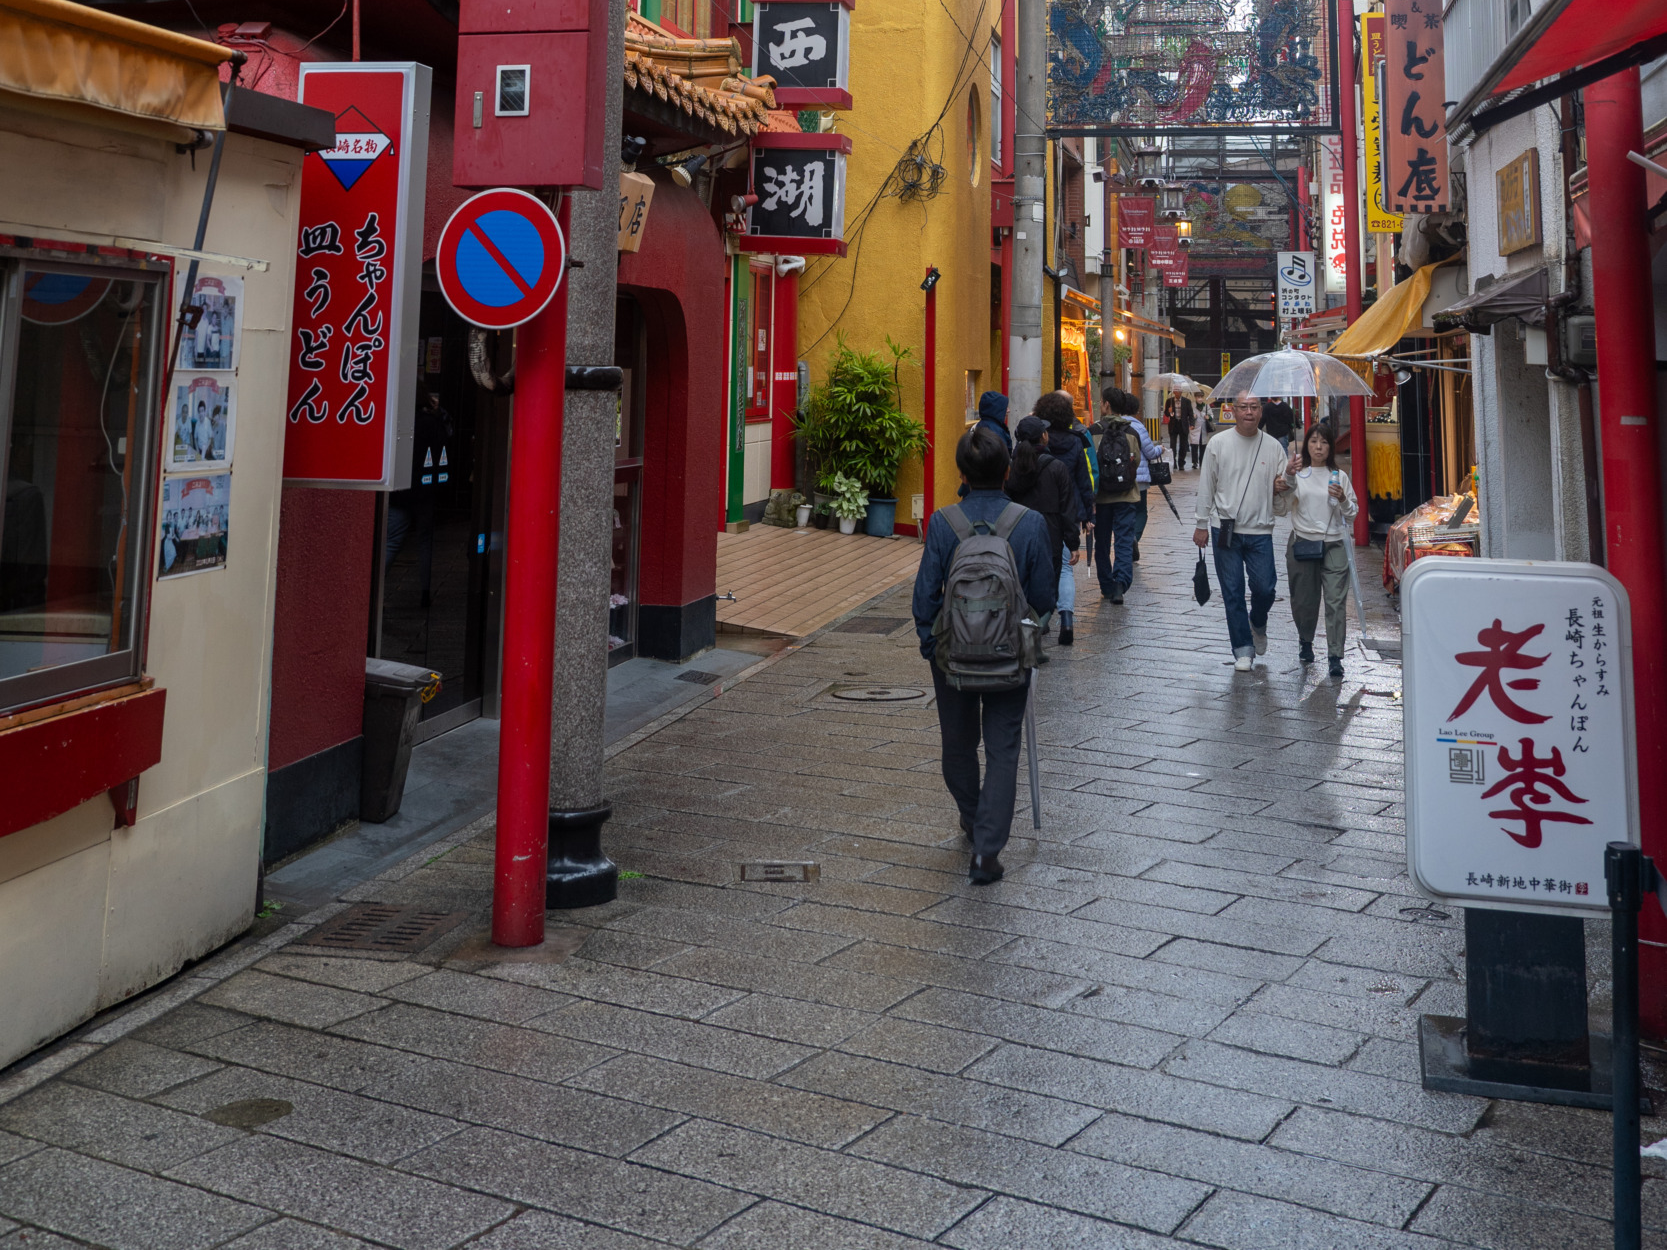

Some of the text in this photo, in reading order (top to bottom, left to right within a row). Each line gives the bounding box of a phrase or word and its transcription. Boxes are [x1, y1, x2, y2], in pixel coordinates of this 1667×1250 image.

[1411, 1, 1423, 13] &
[768, 17, 827, 72] 西
[1397, 40, 1441, 202] どん底
[761, 160, 825, 227] 湖
[288, 220, 345, 425] 皿うどん
[336, 211, 387, 425] ちゃんぽん
[1282, 307, 1313, 315] 村上眼科
[1564, 607, 1590, 754] 長崎ちゃんぽん
[1438, 728, 1495, 739] Lao Lee Group
[1464, 871, 1573, 895] 長崎新地中華街
